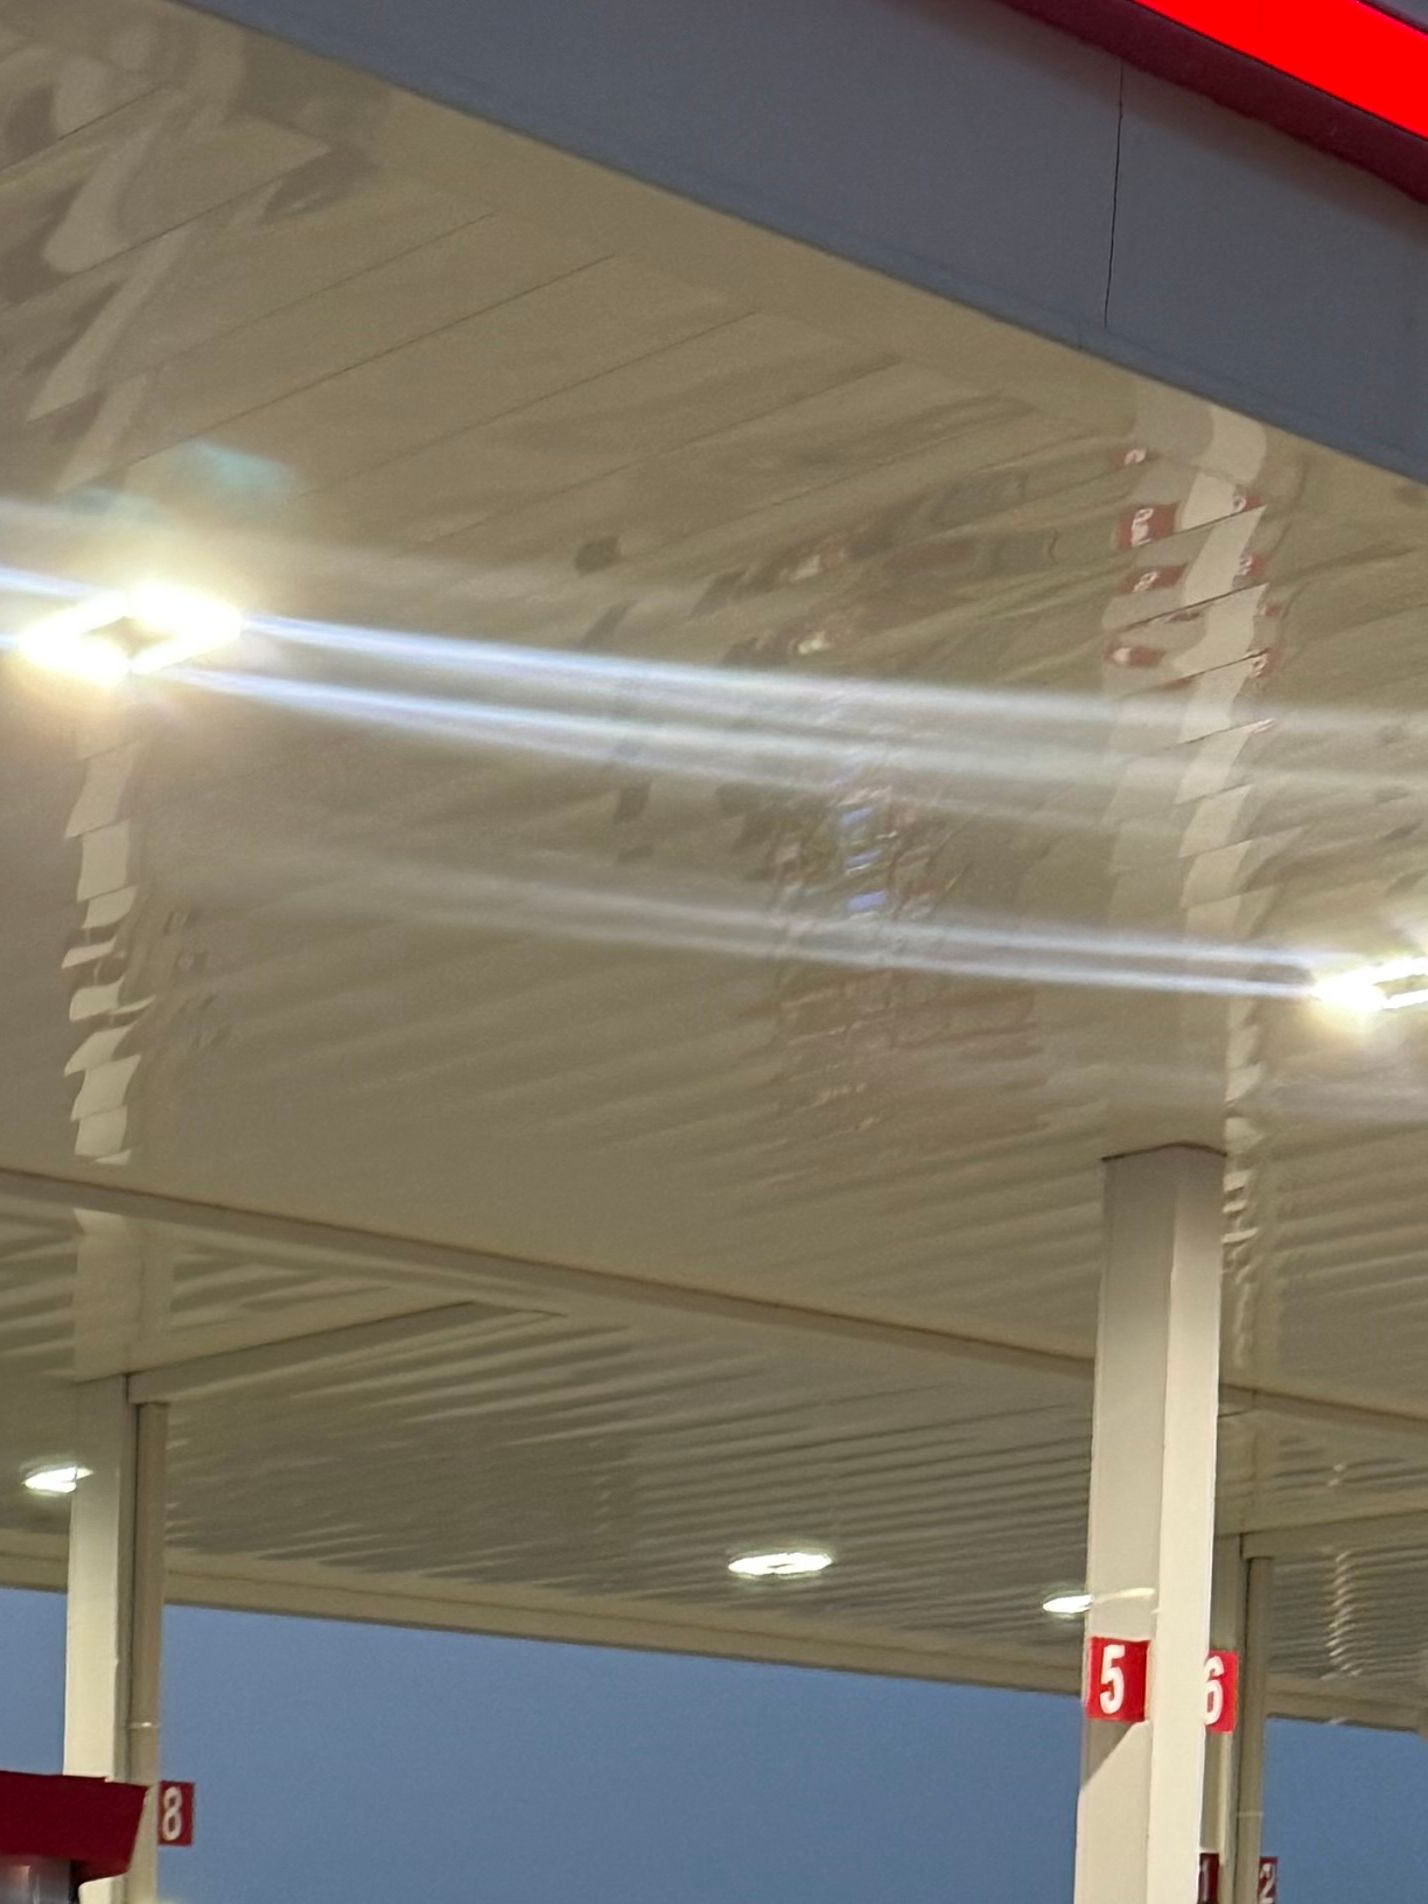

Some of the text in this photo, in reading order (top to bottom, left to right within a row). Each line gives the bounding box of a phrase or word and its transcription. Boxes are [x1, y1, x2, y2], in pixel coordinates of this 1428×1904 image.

[1099, 1643, 1126, 1715] 5
[1203, 1655, 1225, 1726] 6
[163, 1786, 183, 1841] 8
